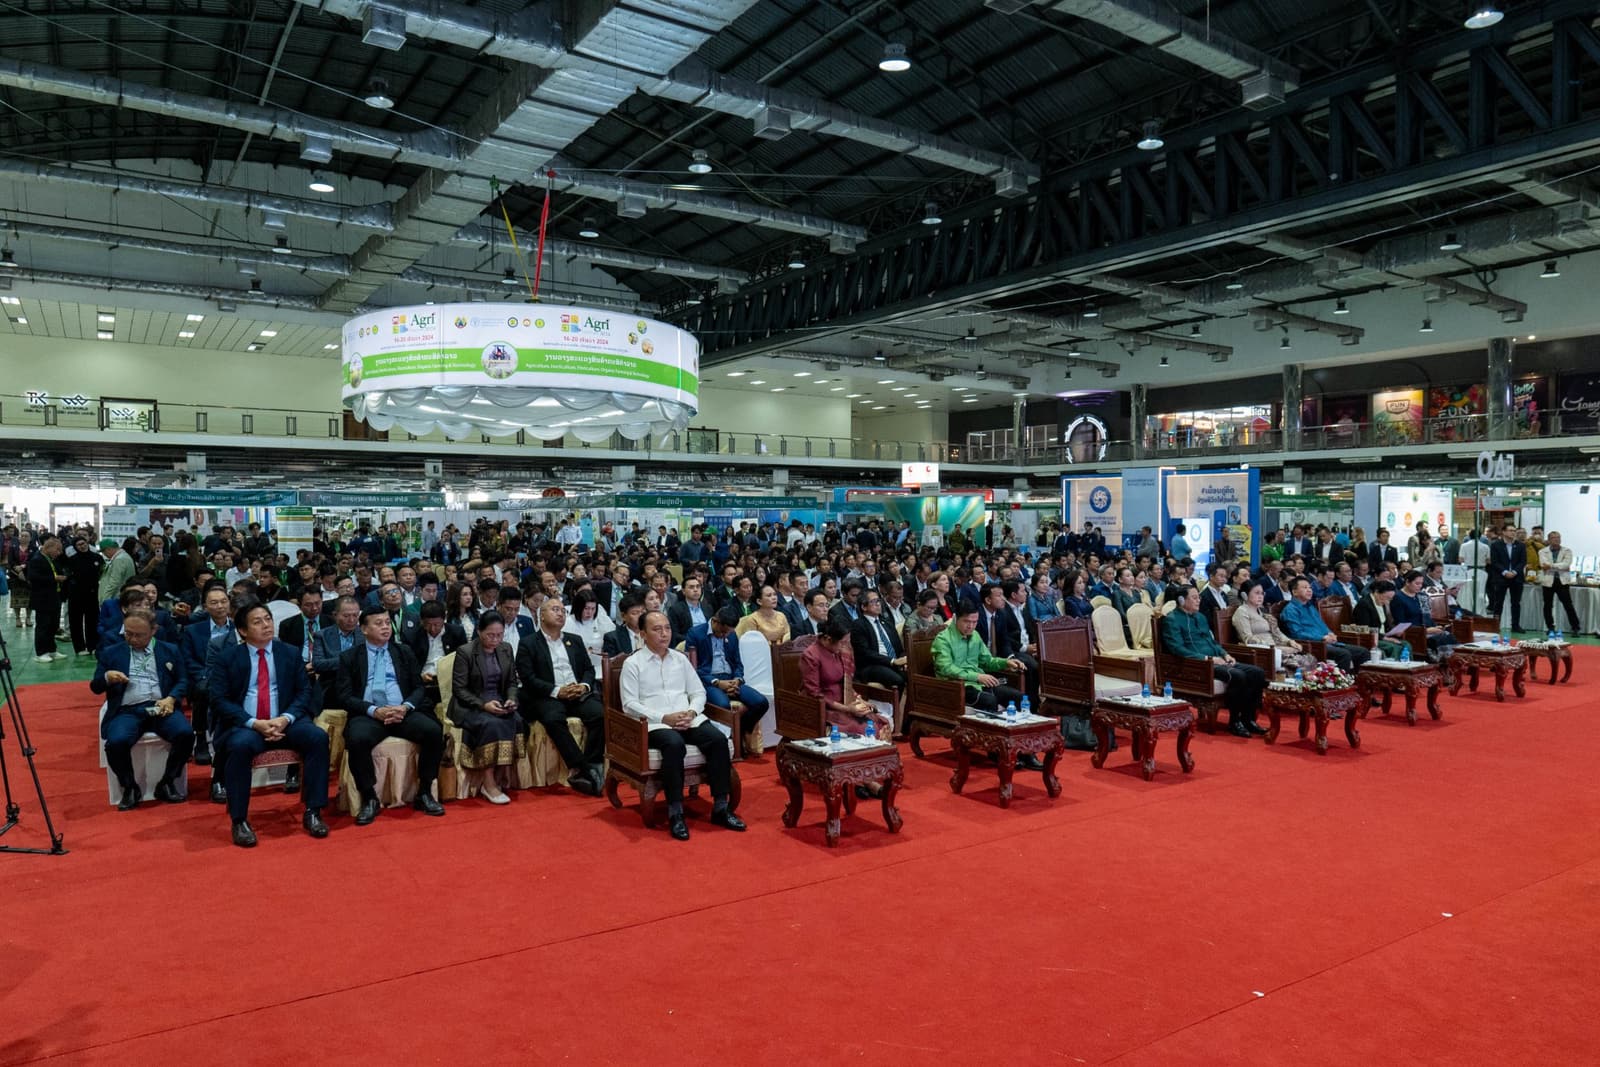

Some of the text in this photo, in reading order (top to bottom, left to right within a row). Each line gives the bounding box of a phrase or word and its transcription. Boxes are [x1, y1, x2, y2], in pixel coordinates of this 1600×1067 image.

[411, 312, 436, 328] Agri
[584, 316, 610, 332] Agri
[1438, 406, 1469, 418] FUN
